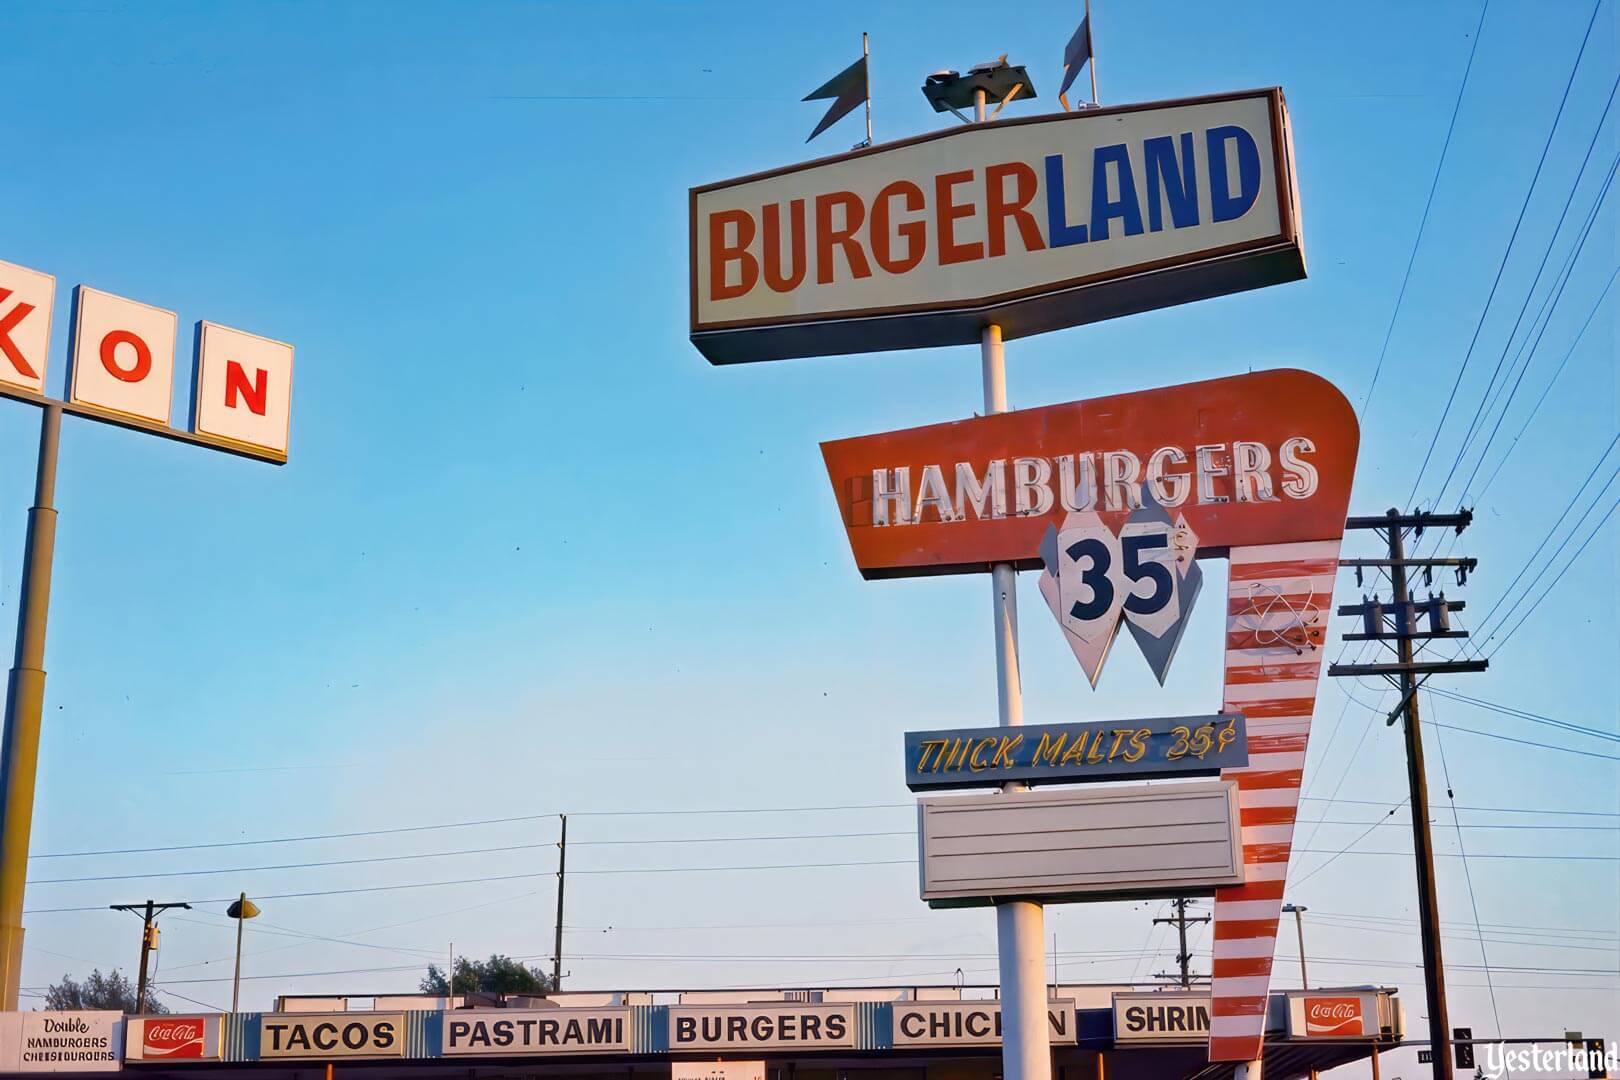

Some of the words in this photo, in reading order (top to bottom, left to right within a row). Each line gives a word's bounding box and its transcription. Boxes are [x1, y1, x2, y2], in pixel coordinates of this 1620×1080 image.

[709, 125, 1261, 301] BURGERLAND
[872, 437, 1319, 527] HAMBURGERS
[917, 733, 1024, 774] THICK
[1032, 728, 1152, 768] MALTS
[43, 1017, 90, 1034] Double
[266, 1022, 396, 1052] TACOS
[449, 1017, 624, 1047] PASTRAMI
[676, 1014, 847, 1043] BURGERS
[900, 1010, 1066, 1038] CHICN
